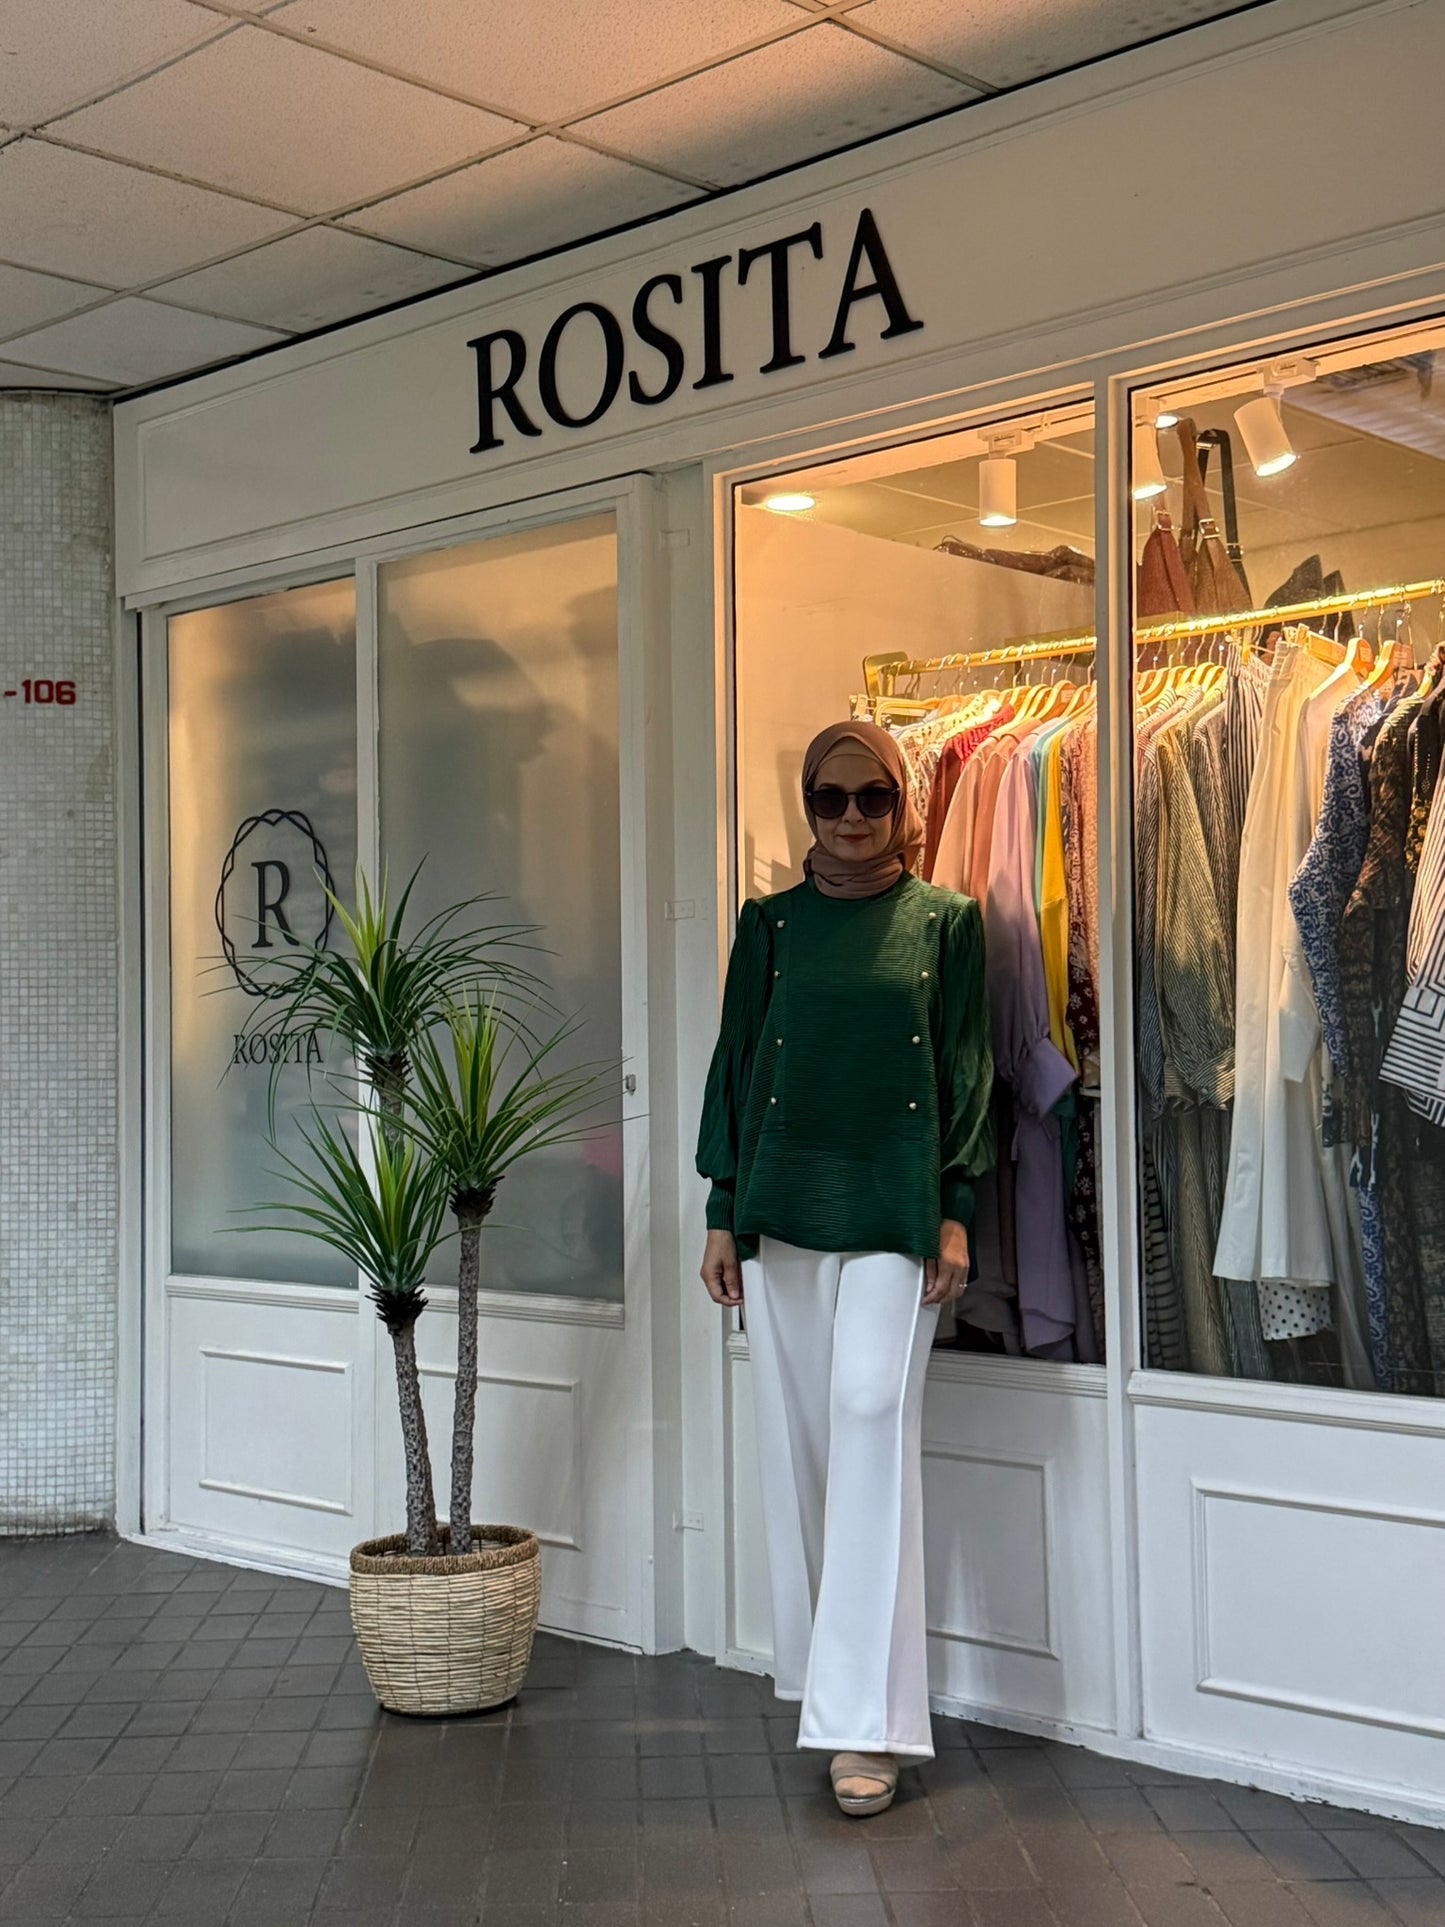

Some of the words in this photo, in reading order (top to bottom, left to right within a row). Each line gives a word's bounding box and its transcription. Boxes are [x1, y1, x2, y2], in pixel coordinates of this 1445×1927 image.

[467, 207, 924, 454] ROSITA
[4, 679, 77, 705] -106
[251, 859, 300, 948] R
[233, 1030, 324, 1065] ROSITA
